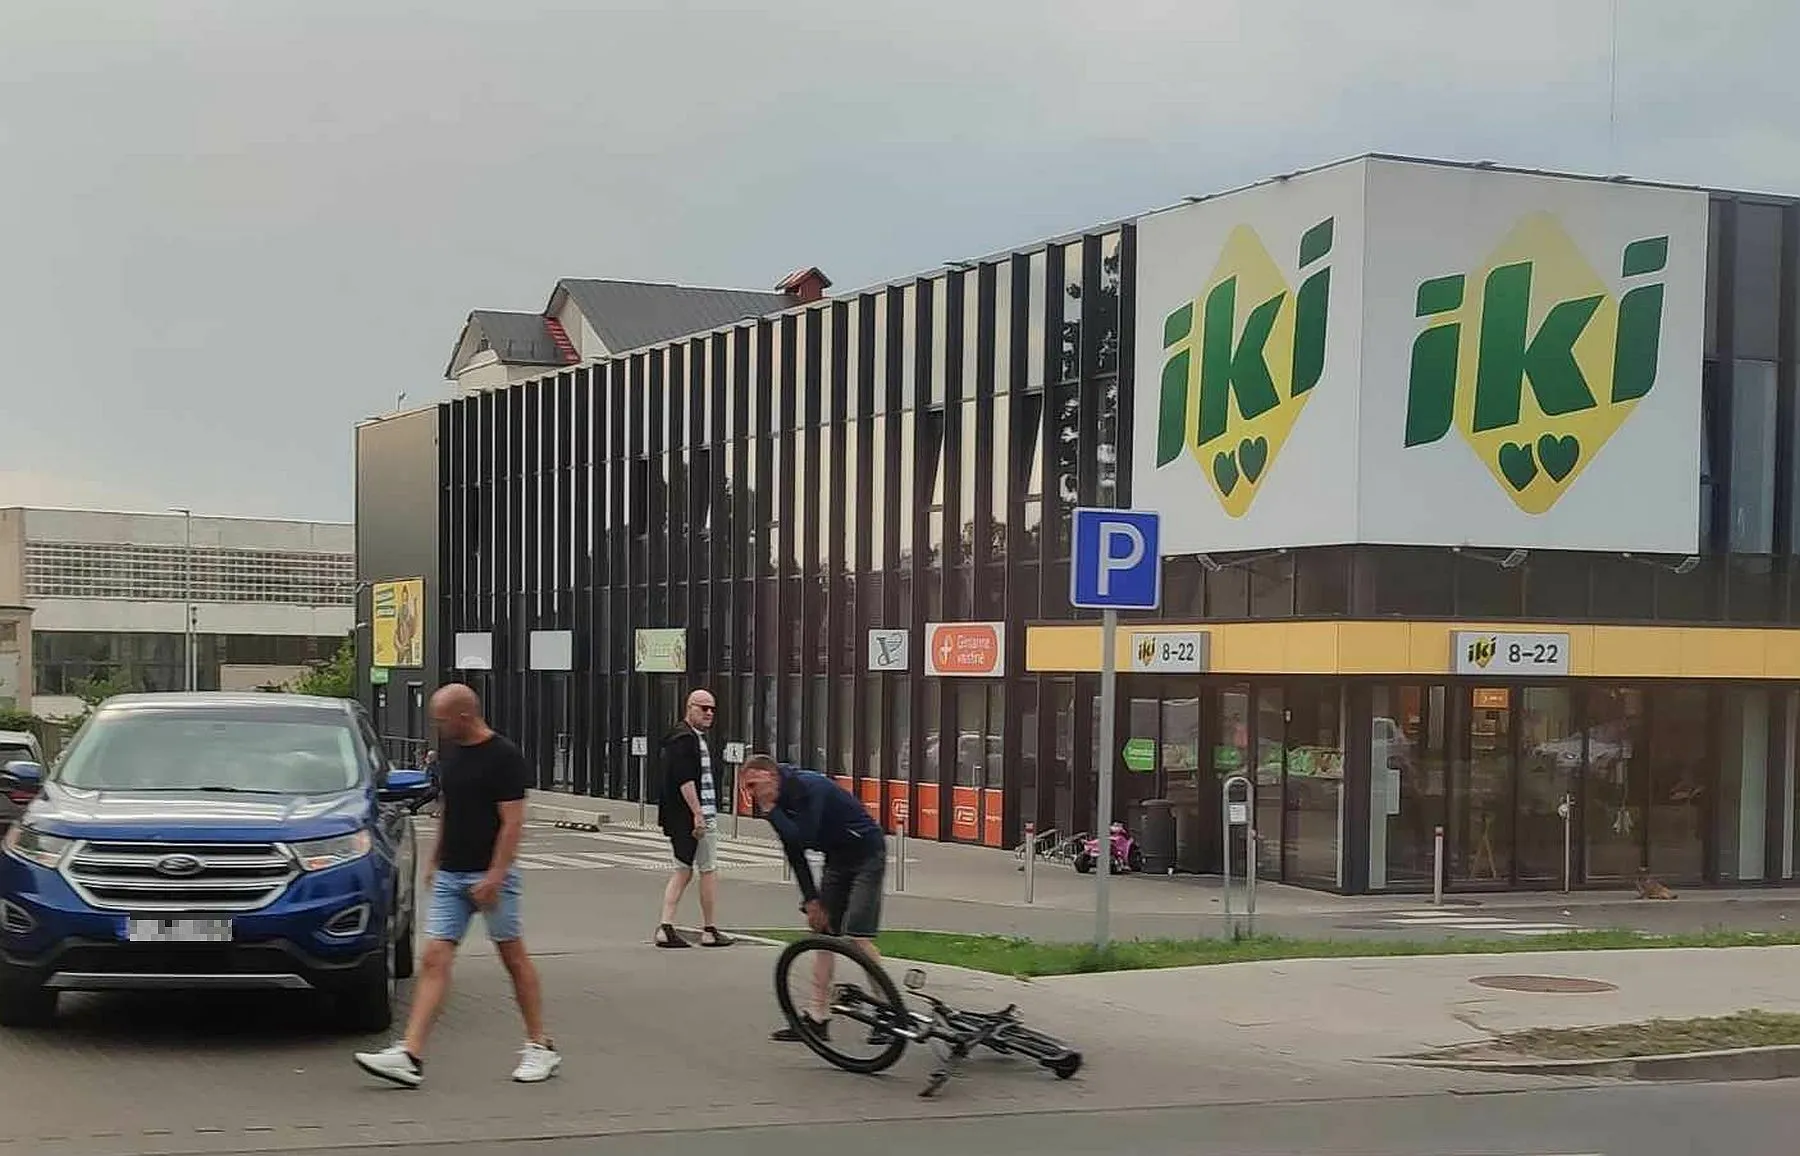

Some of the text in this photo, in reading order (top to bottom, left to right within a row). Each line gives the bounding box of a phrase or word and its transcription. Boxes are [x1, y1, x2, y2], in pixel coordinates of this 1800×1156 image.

[1156, 217, 1334, 468] iki
[1404, 236, 1669, 448] iki
[1097, 521, 1145, 596] P
[1162, 643, 1194, 661] 8-22
[1468, 637, 1559, 663] iki 8-22
